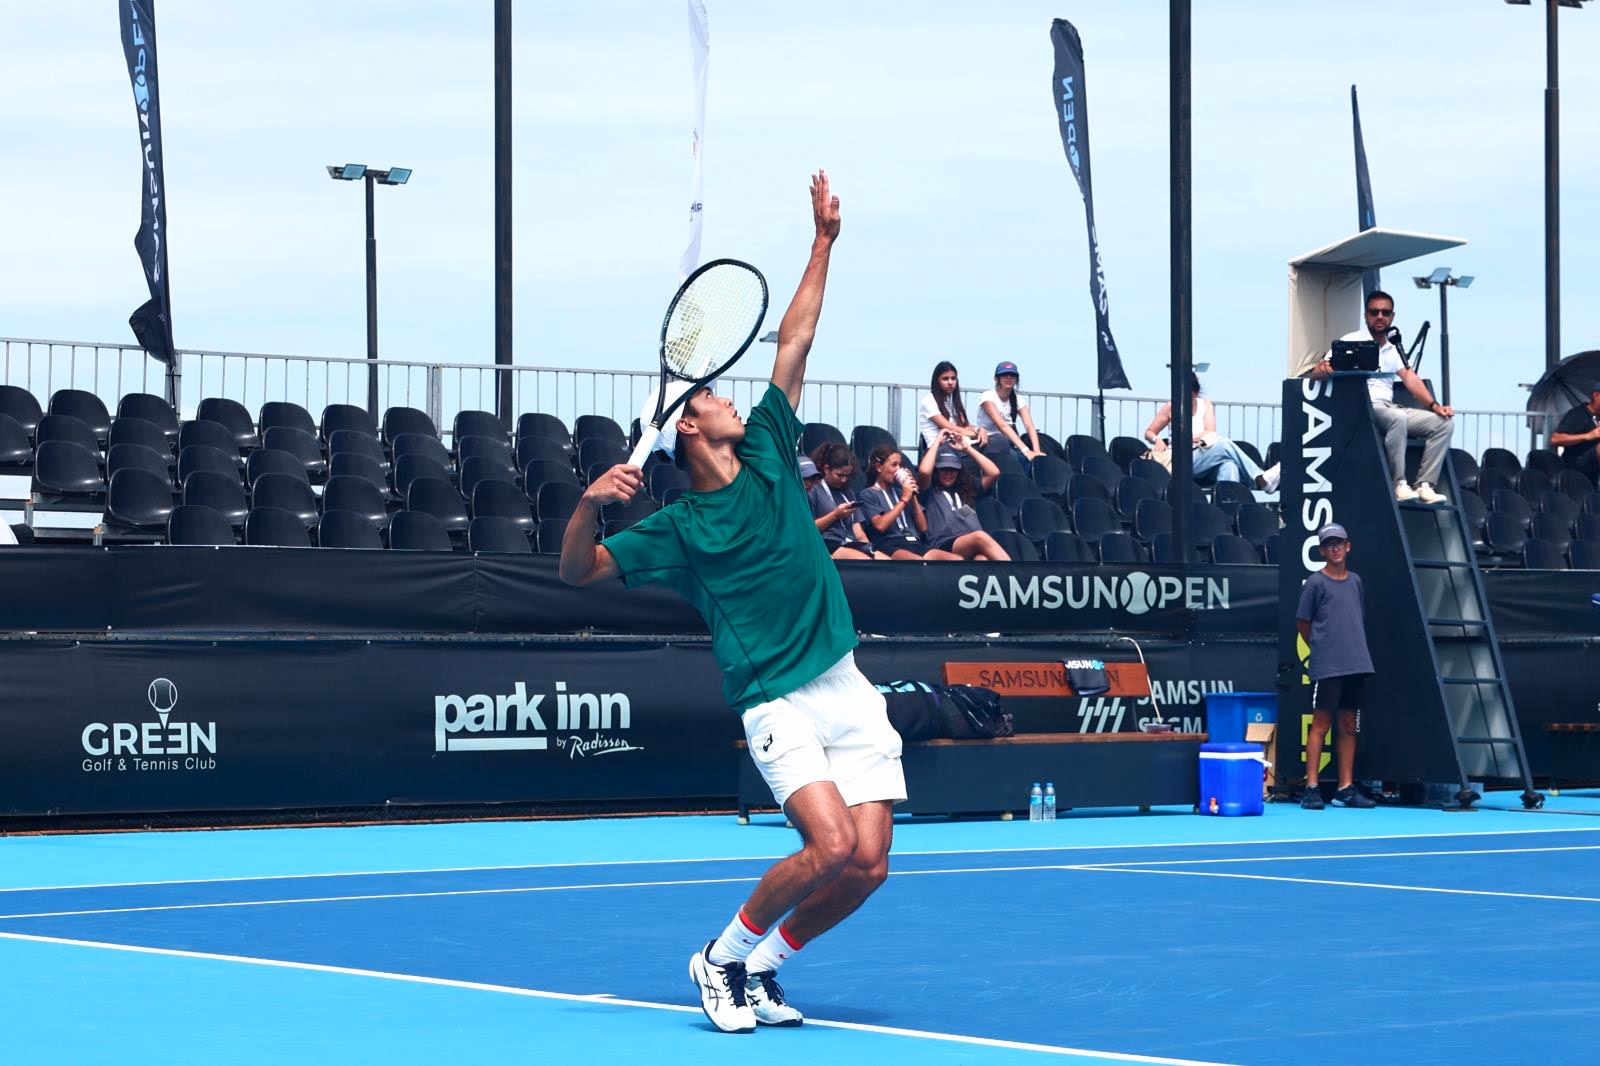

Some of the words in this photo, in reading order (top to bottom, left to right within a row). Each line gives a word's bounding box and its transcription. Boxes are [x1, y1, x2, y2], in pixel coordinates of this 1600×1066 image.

[1302, 377, 1333, 586] SAMSU
[435, 682, 547, 751] park
[555, 682, 631, 730] inn
[81, 721, 217, 756] GREEN
[556, 737, 567, 749] by
[569, 732, 644, 759] Radisson
[82, 758, 112, 772] Golf
[117, 758, 127, 771] &
[133, 757, 179, 771] Tennis
[185, 756, 217, 770] Club
